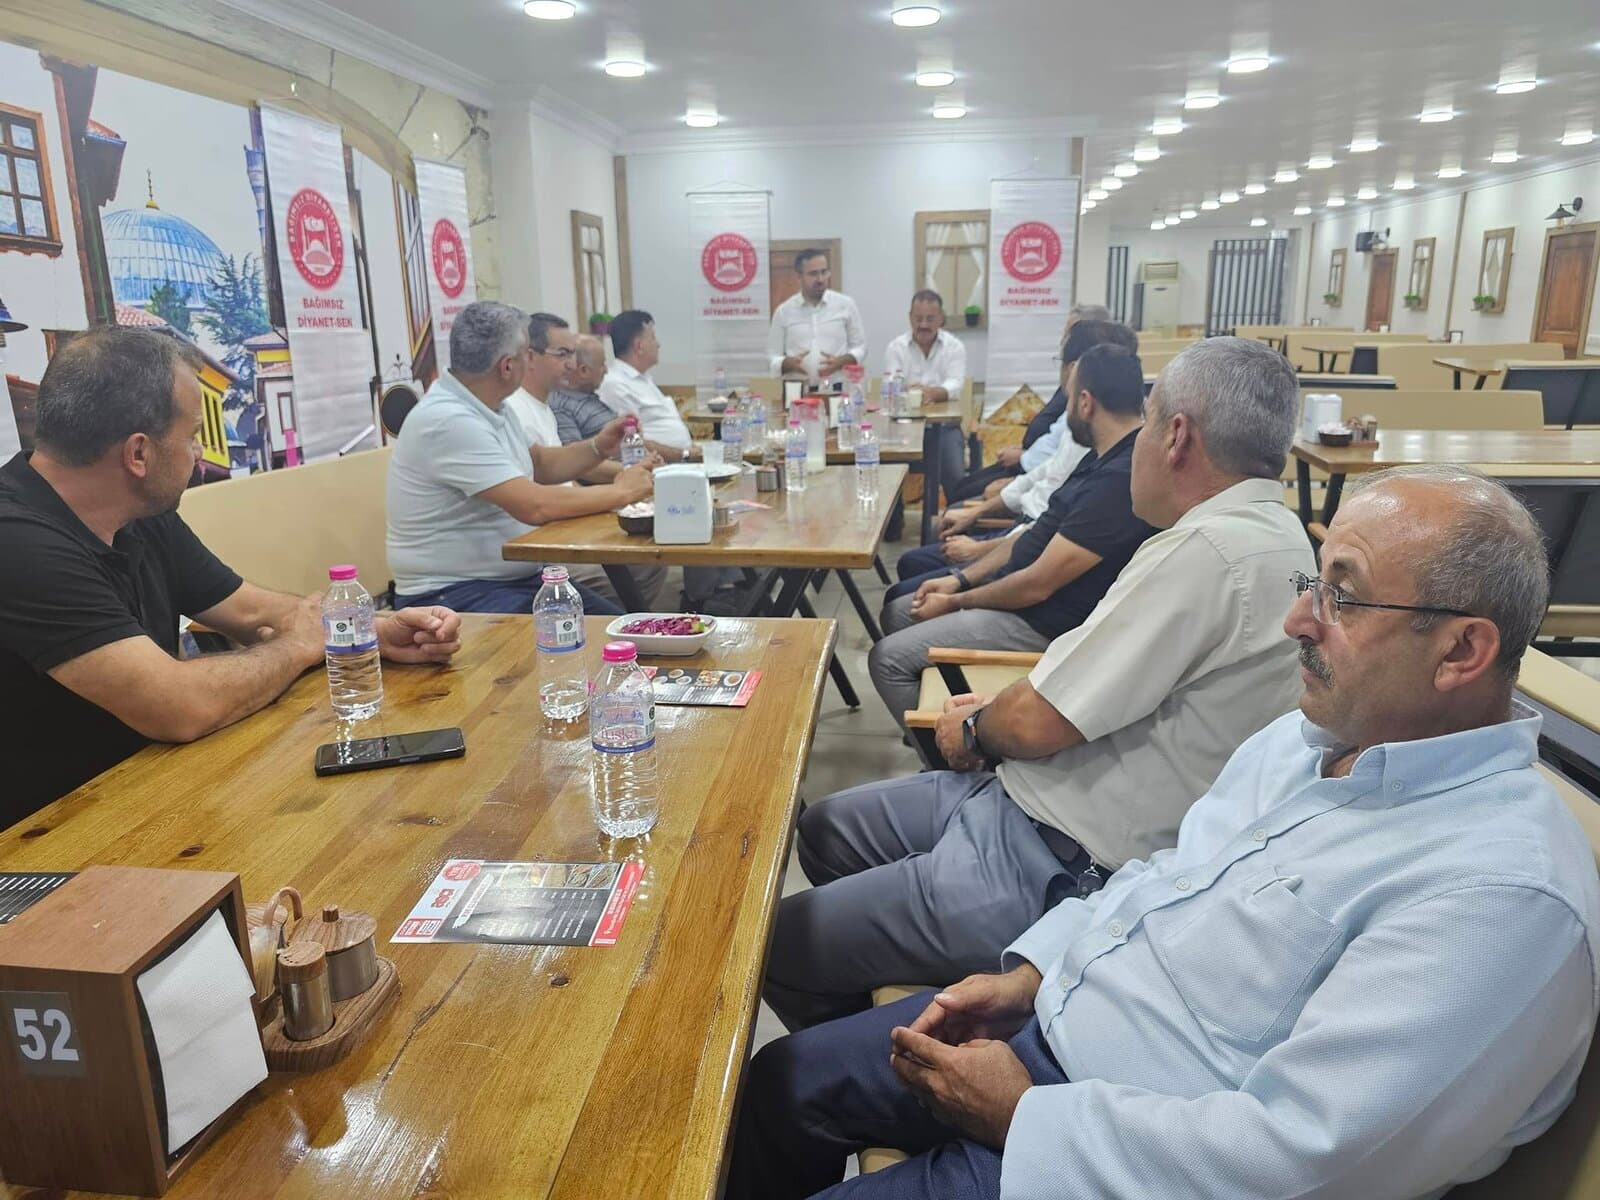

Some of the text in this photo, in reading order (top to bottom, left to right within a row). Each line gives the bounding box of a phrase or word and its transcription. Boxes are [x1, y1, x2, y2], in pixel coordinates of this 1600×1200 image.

[1006, 286, 1052, 295] BAĞIMSIZ
[302, 297, 344, 310] BAĞIMSIZ
[297, 316, 353, 328] DİYANET-SEN
[13, 1007, 79, 1061] 52
